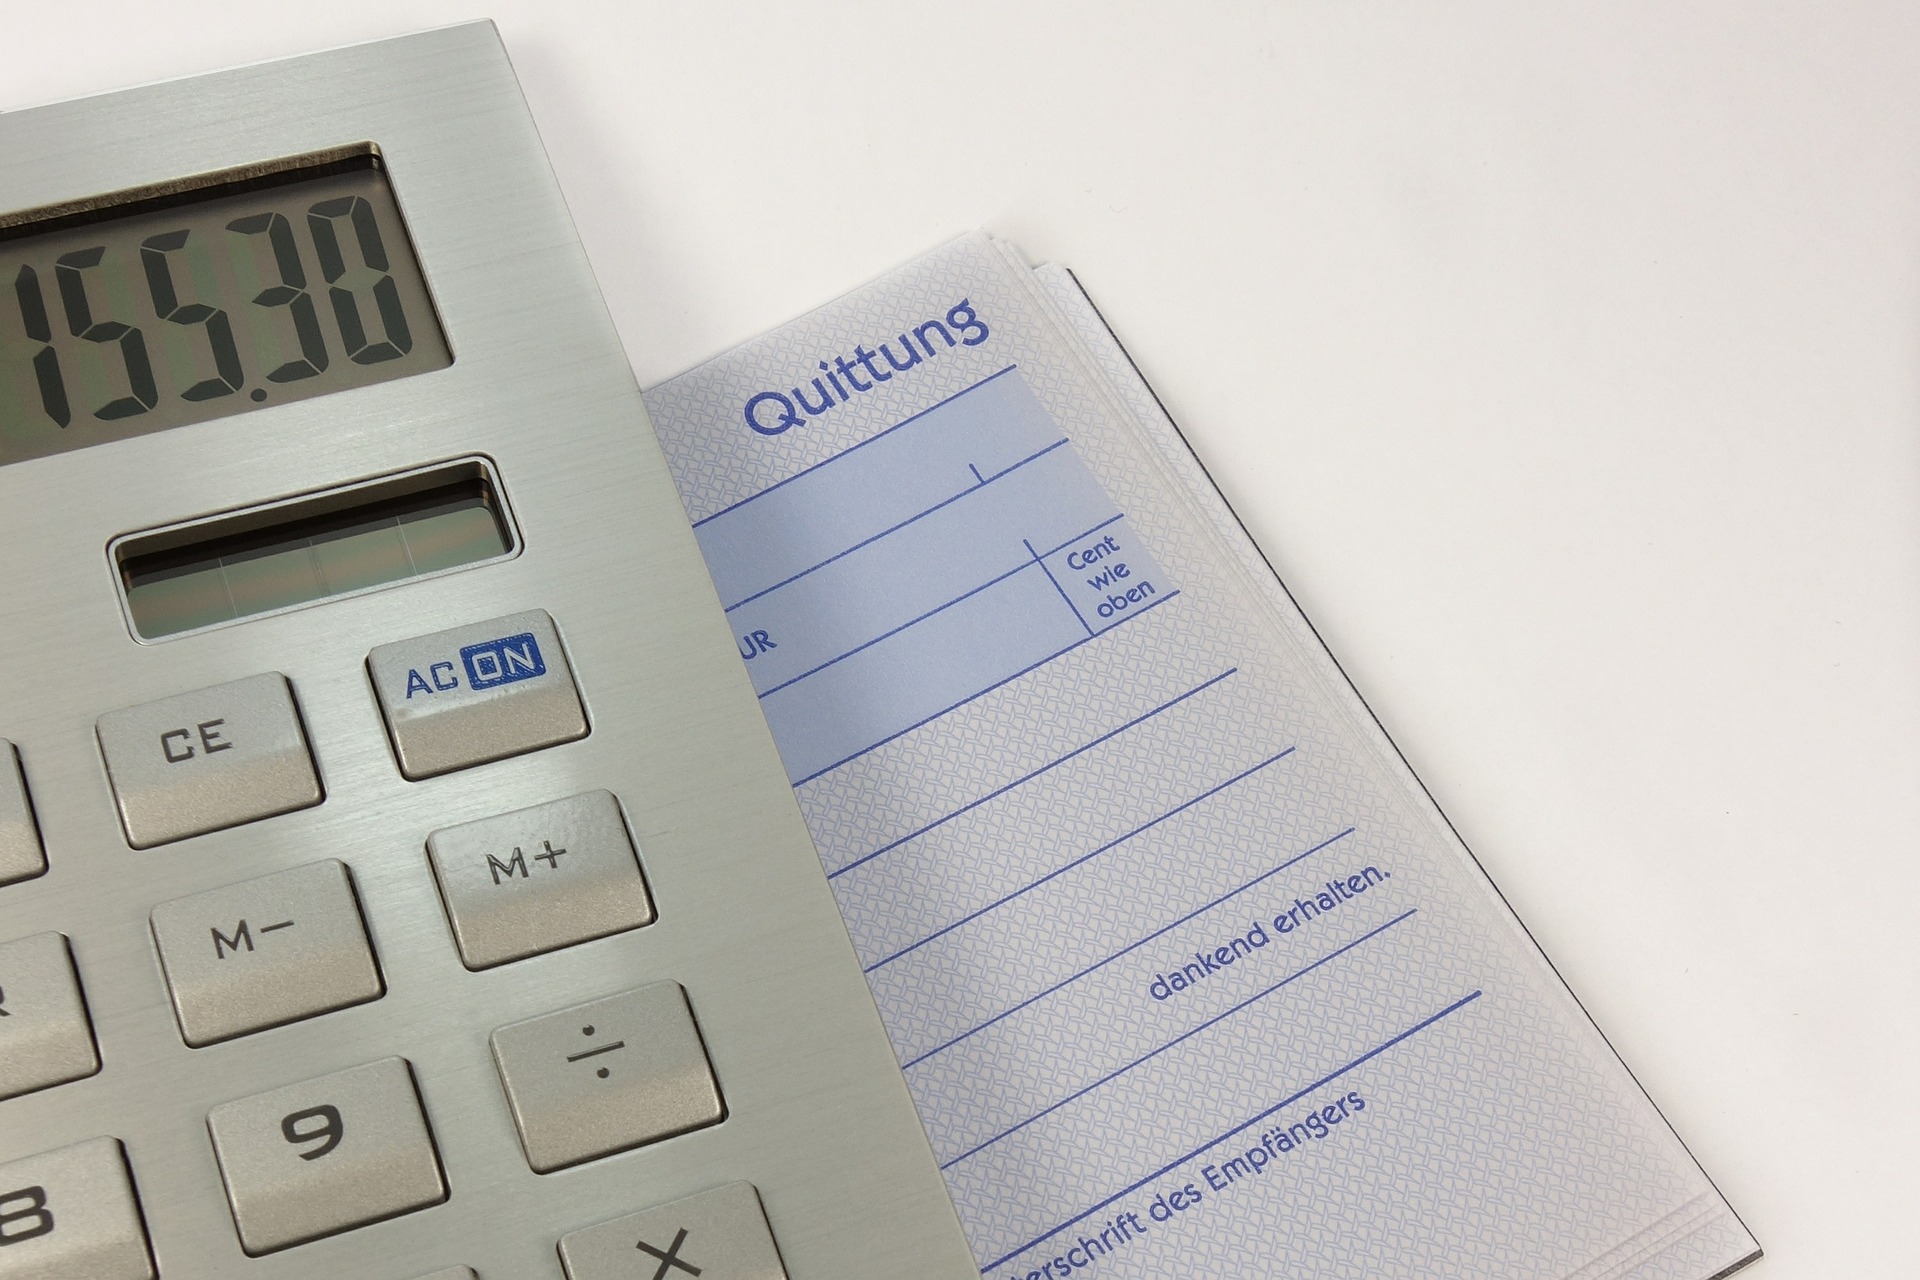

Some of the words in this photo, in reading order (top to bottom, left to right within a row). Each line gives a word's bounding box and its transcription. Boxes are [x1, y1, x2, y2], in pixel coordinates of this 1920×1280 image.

[15, 196, 413, 429] 155.30
[744, 298, 990, 436] Quittung
[1067, 535, 1121, 570] Cent
[1087, 563, 1131, 591] wie
[1097, 580, 1156, 617] oben
[406, 661, 459, 699] AC
[471, 641, 537, 682] ON
[160, 718, 234, 764] CE
[487, 839, 567, 886] M+
[1149, 921, 1271, 1001] dankend
[1273, 864, 1391, 934] erhalten.
[280, 1104, 344, 1161] 9
[1011, 1211, 1147, 1280] erschrift
[1149, 1182, 1203, 1223] des
[1200, 1090, 1367, 1194] Empfängers
